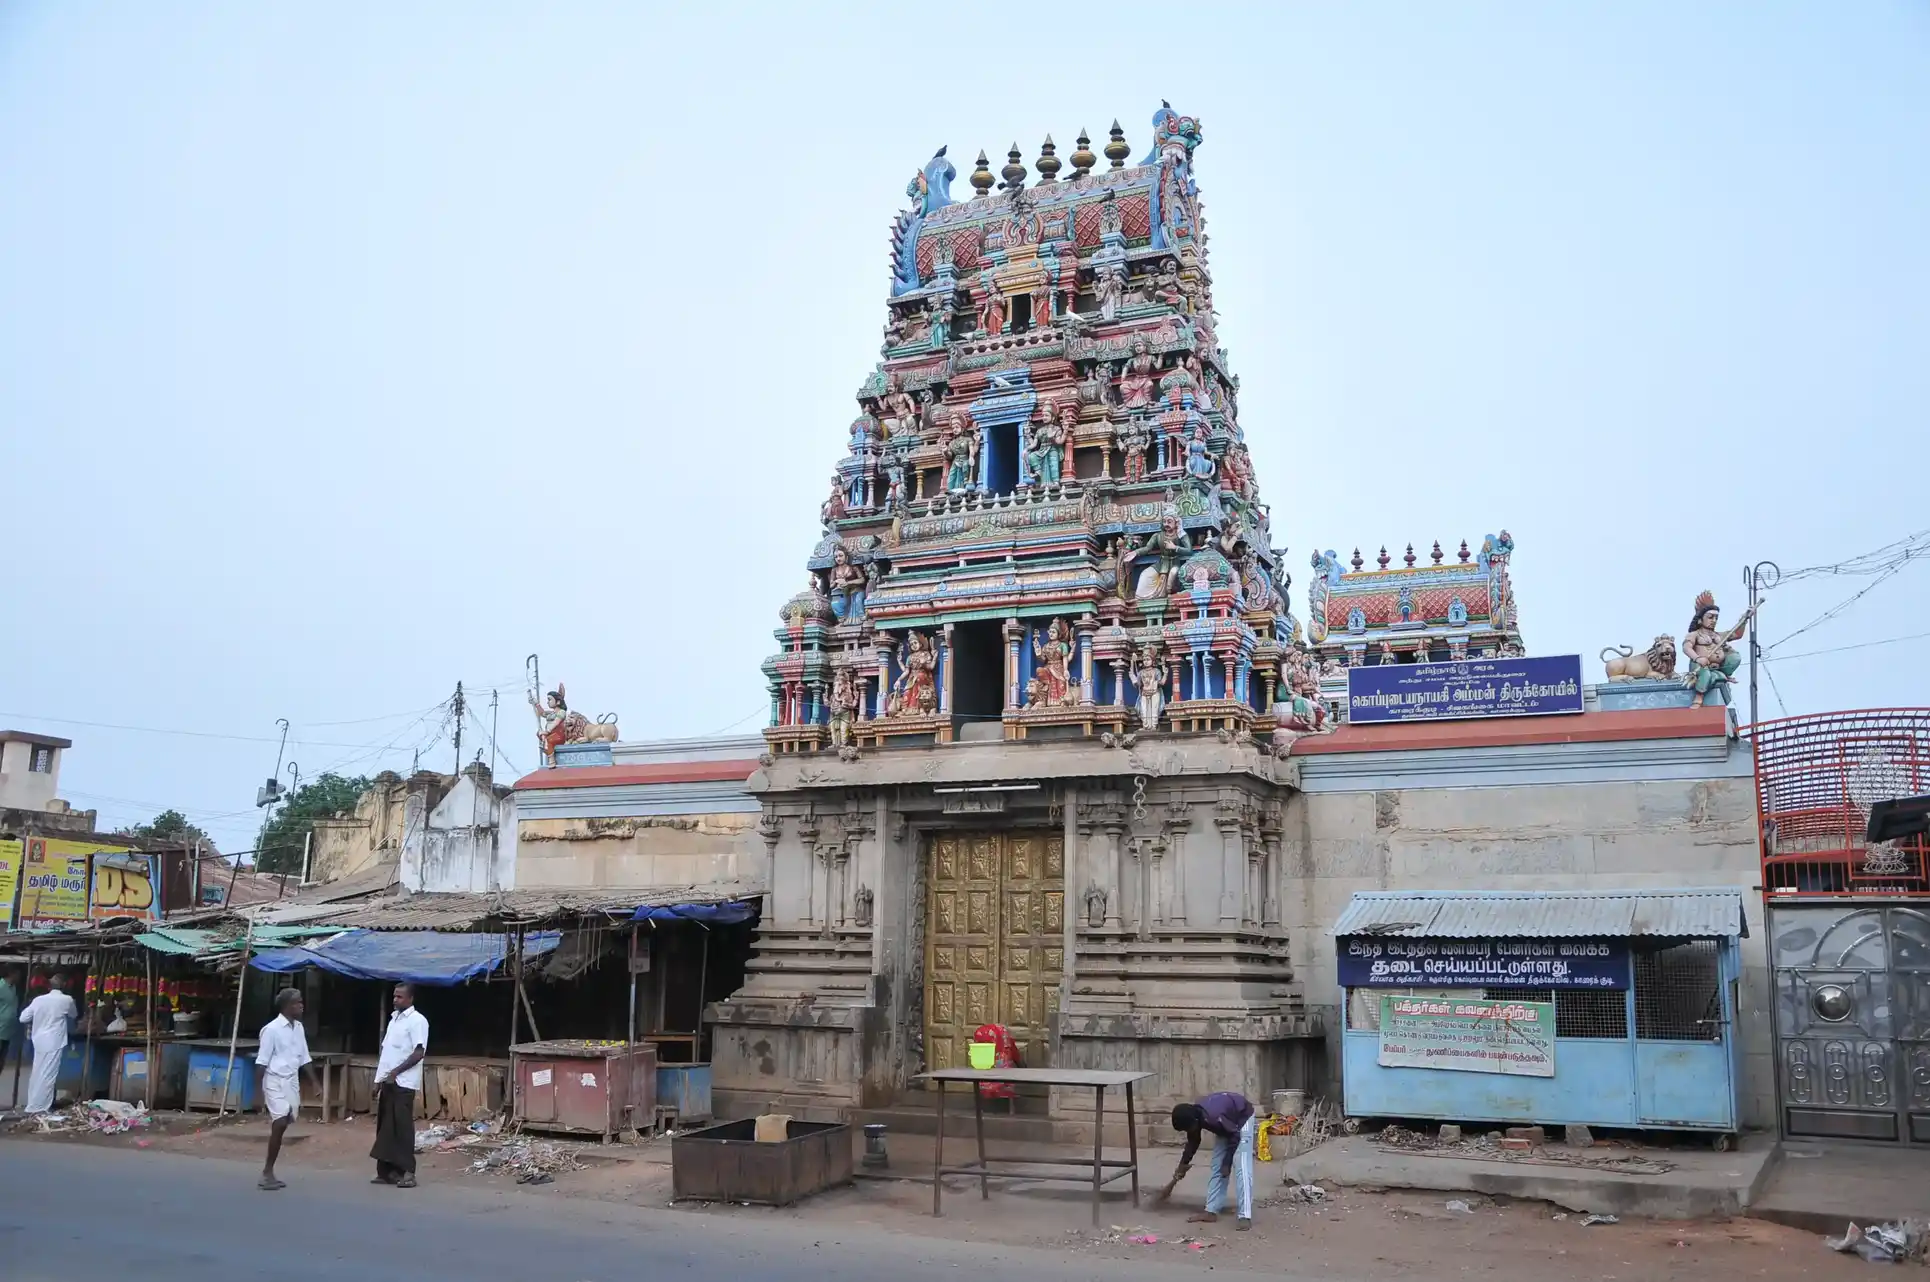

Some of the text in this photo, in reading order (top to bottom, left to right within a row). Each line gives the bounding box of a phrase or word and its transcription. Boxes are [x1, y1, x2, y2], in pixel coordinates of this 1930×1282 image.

[1351, 677, 1578, 709] கொப்புடையநாயகி அம்மன் திருக்கோயில்
[1369, 956, 1572, 978] தடை செய்யப்பட்டுள்ளது.
[1393, 1000, 1452, 1015] பக்தர்கள்
